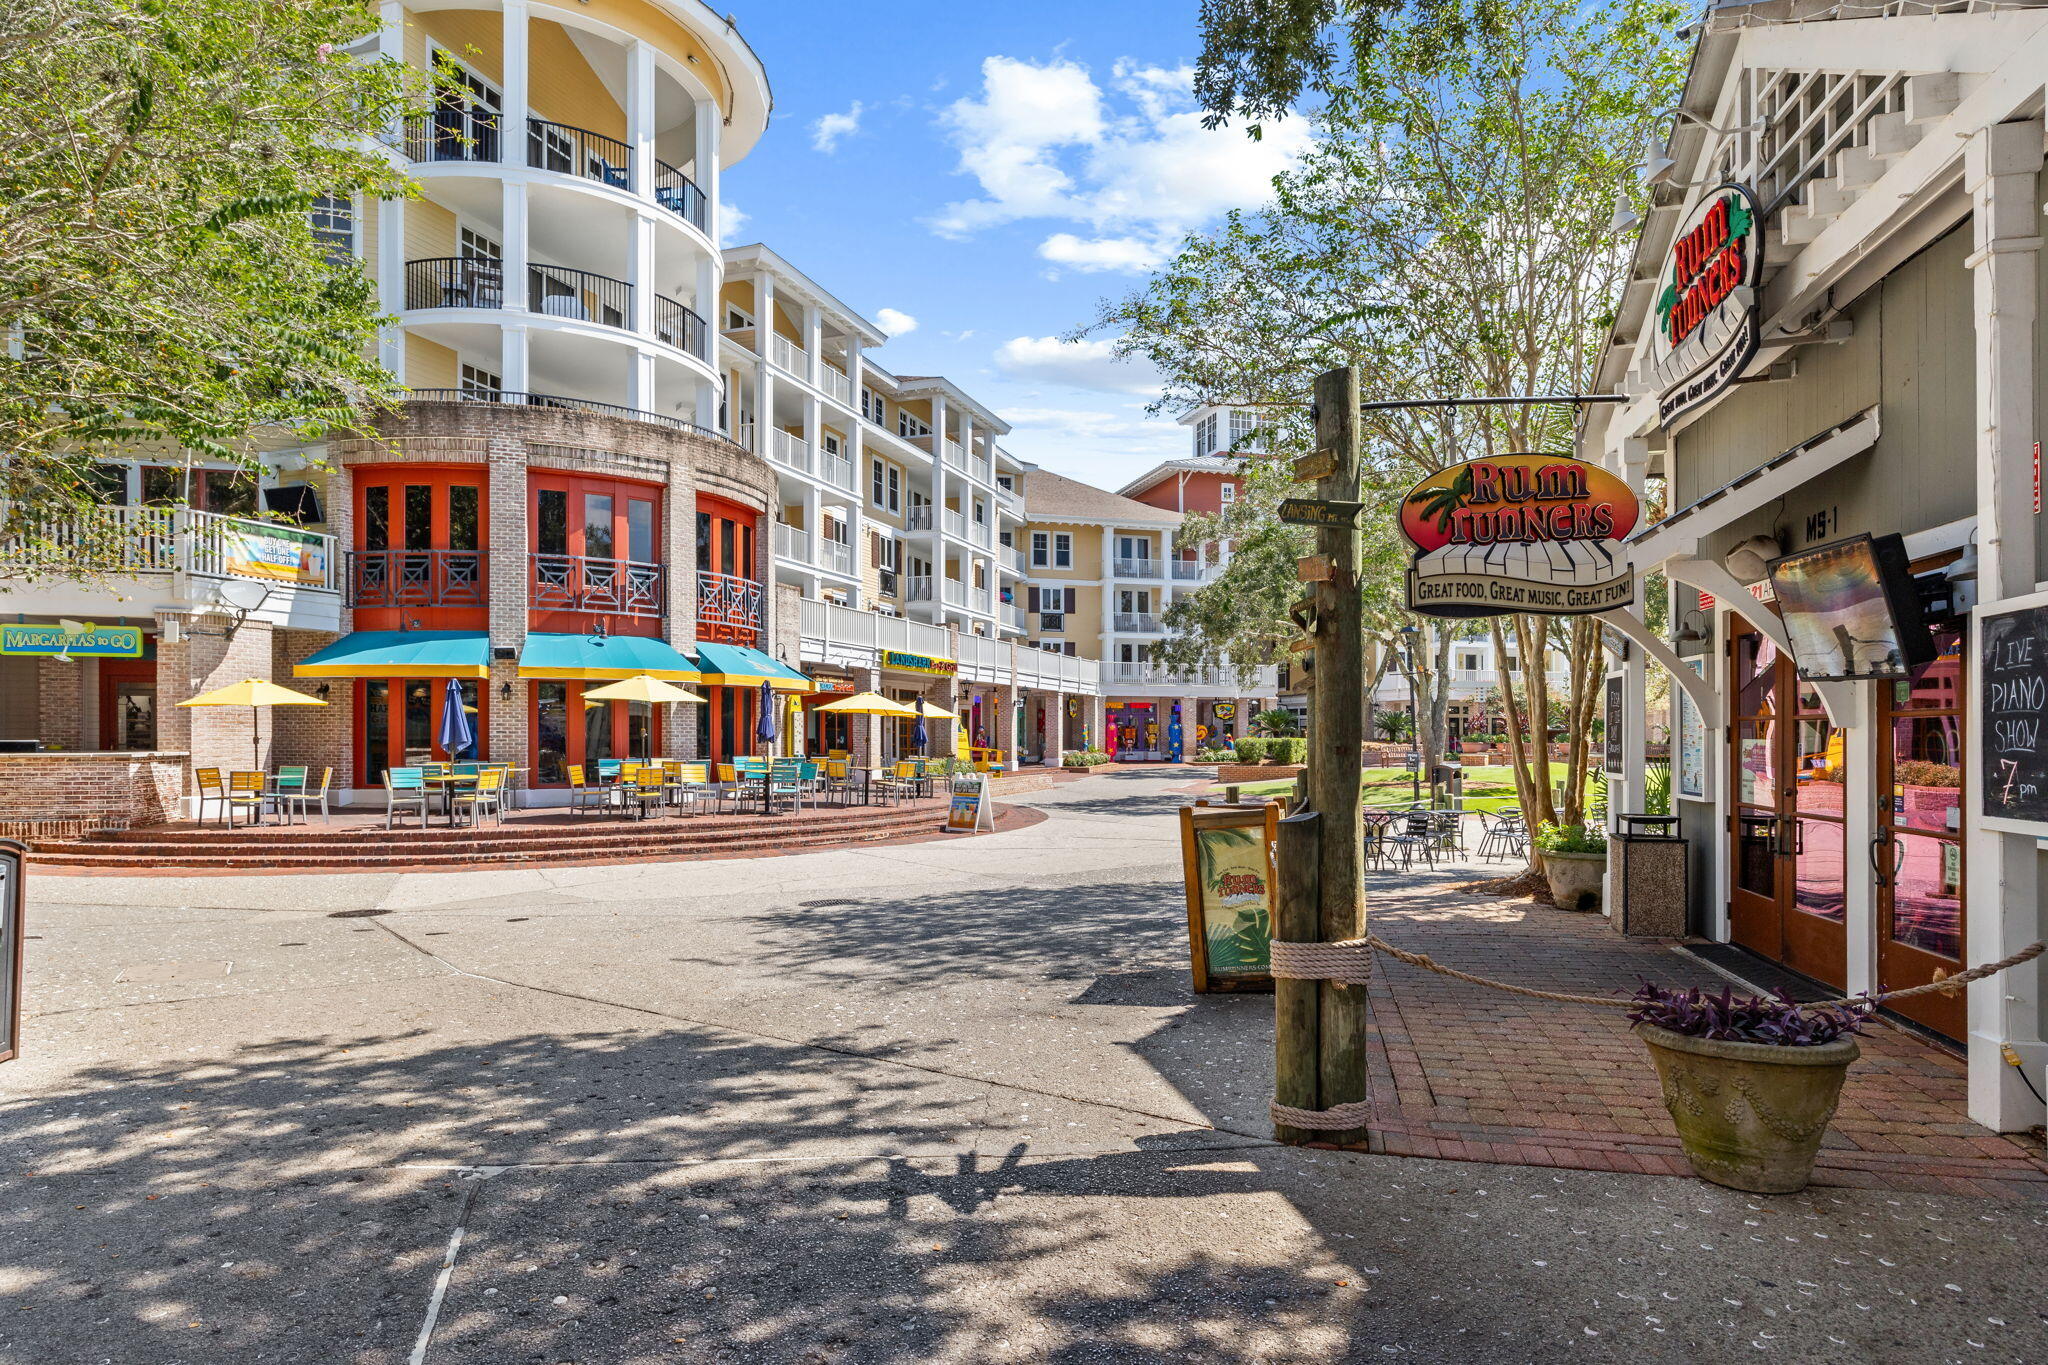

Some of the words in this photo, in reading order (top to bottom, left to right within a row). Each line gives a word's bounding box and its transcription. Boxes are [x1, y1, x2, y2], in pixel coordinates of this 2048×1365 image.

[1418, 581, 1454, 600] GREAT
[1456, 581, 1488, 601] FOOD,
[1490, 580, 1525, 604] GREAT
[1528, 589, 1565, 608] MUSIC,
[1567, 588, 1603, 607] GREAT
[1605, 580, 1631, 603] FUN!
[110, 632, 137, 650] GO
[1994, 637, 2035, 671] LIVE
[1991, 675, 2046, 712] PIANO
[1994, 717, 2040, 753] SHOW
[2000, 758, 2018, 805] 7
[2019, 783, 2038, 799] pm
